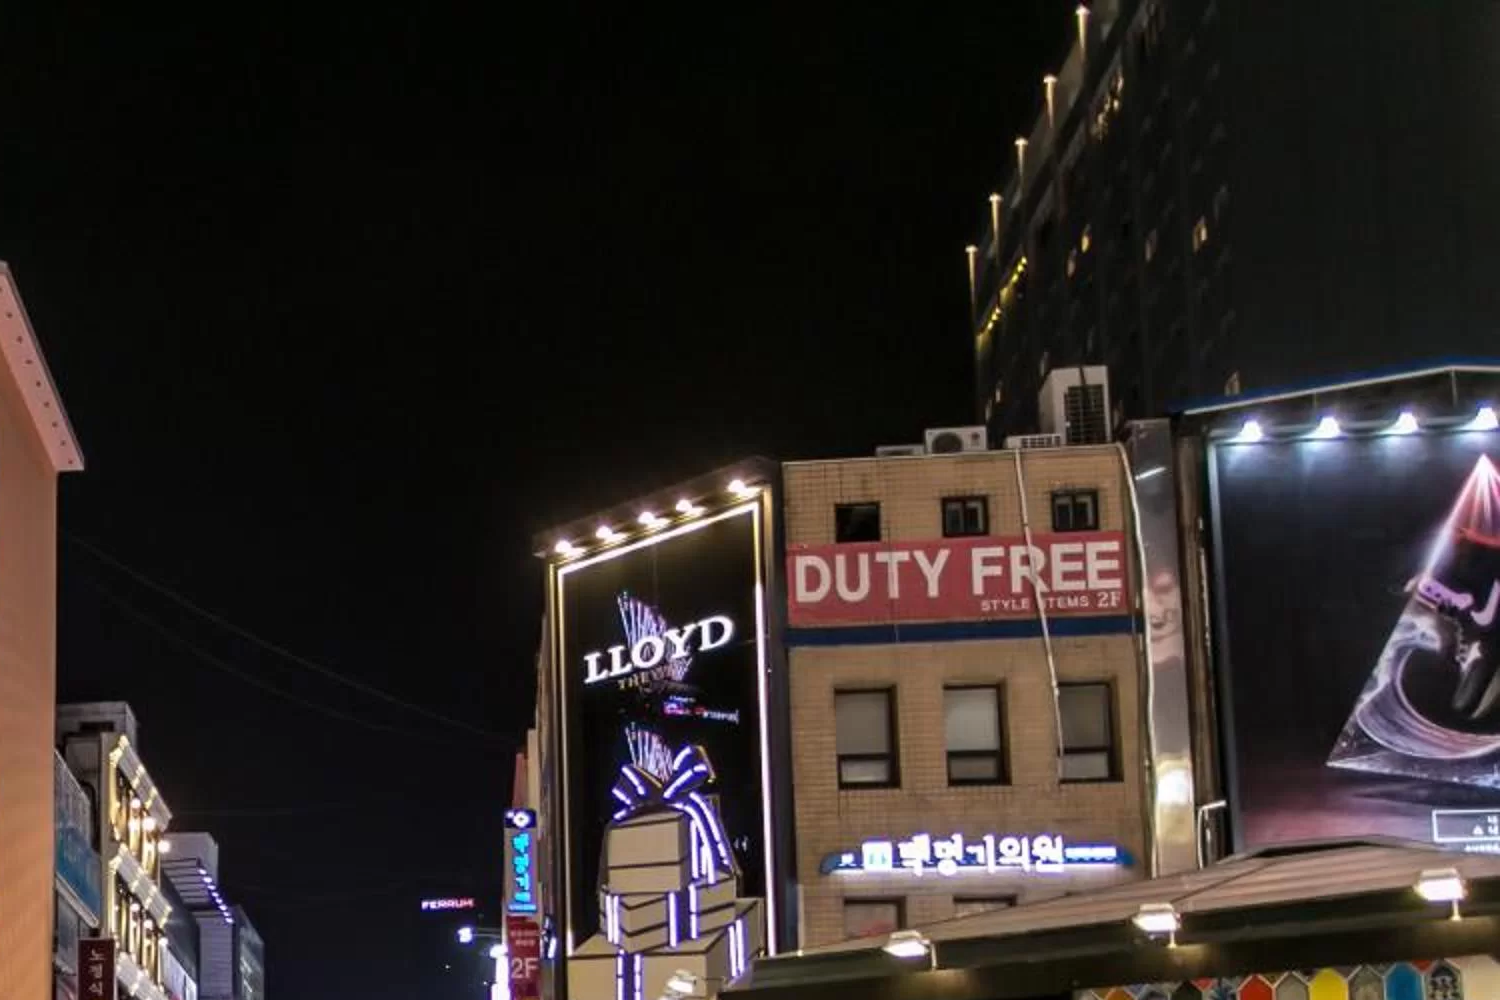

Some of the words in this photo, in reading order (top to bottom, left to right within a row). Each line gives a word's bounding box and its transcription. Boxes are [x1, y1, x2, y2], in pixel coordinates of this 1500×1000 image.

[794, 549, 950, 603] DUTY
[971, 540, 1122, 596] FREE
[981, 598, 1030, 612] STYLE
[1041, 595, 1090, 611] TEMS
[1097, 591, 1122, 609] 2F
[583, 614, 735, 685] LLOYD
[511, 958, 540, 979] 2F
